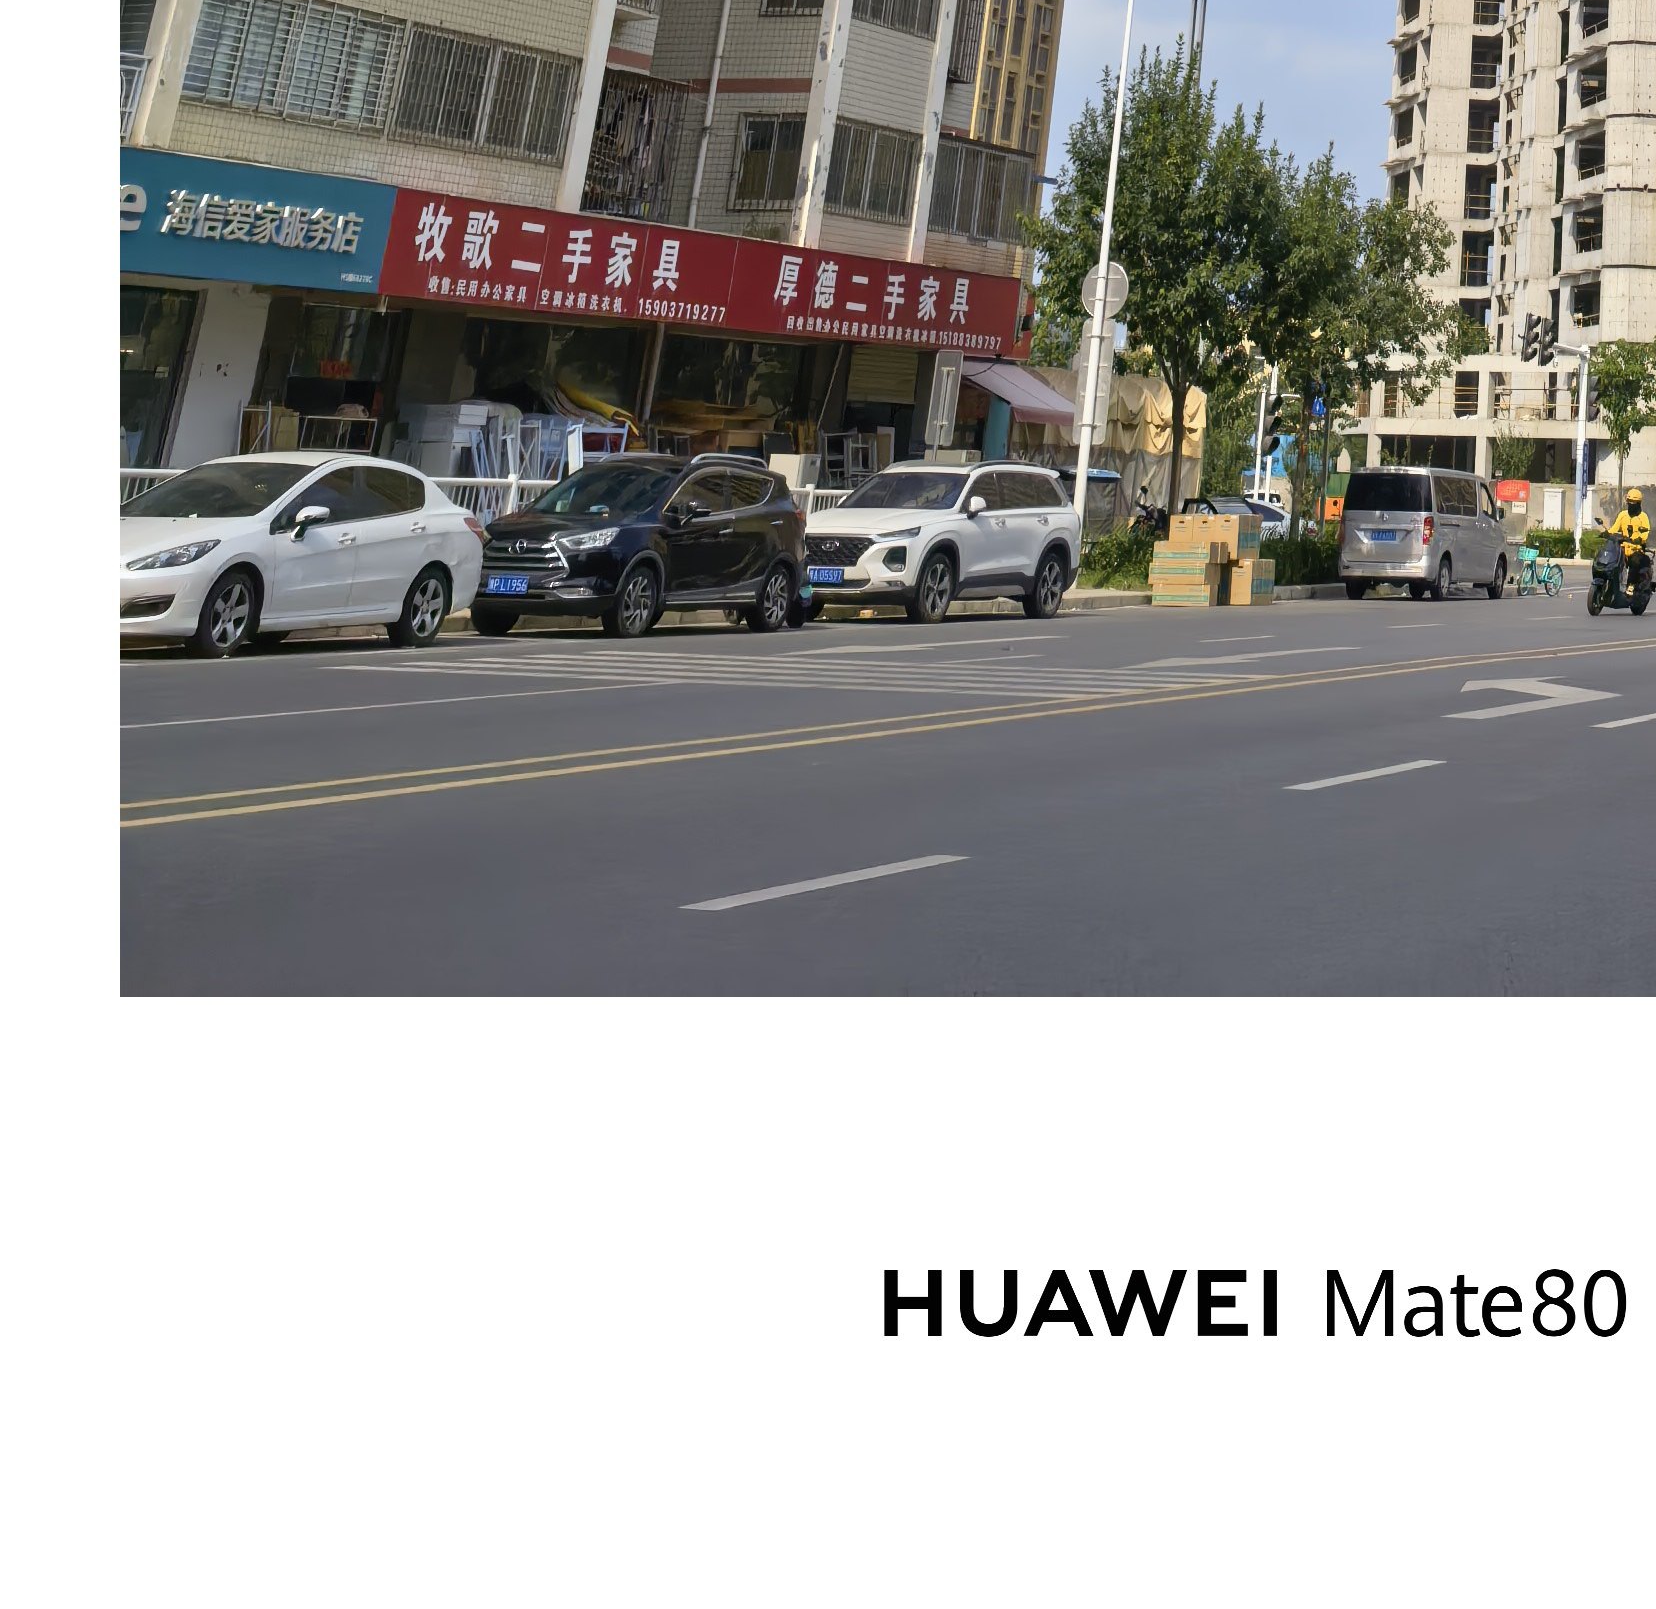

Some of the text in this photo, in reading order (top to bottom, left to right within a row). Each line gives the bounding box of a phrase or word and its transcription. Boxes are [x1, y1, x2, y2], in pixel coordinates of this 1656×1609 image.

[160, 189, 364, 254] 海信爱家服务店
[415, 202, 680, 292] 牧歌二手家具
[638, 297, 726, 323] 15903719277
[773, 254, 970, 325] 厚德二手家具
